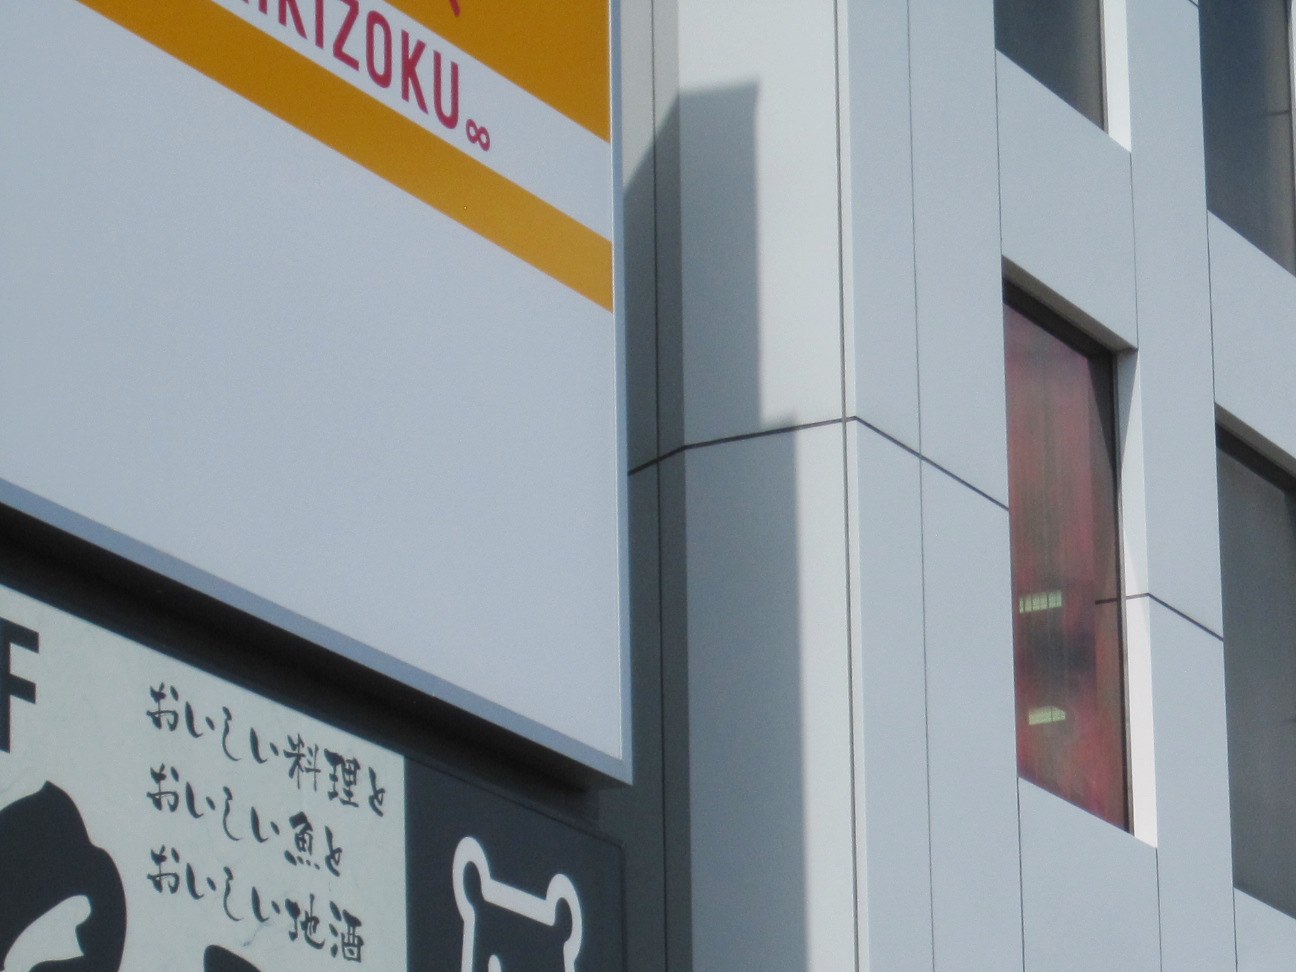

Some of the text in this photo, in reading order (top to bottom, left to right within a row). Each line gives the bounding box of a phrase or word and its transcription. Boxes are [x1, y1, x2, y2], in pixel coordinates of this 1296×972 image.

[146, 682, 386, 817] おいしい料理と
[146, 763, 343, 877] おいしい魚と
[146, 845, 364, 963] おいしい地酒
